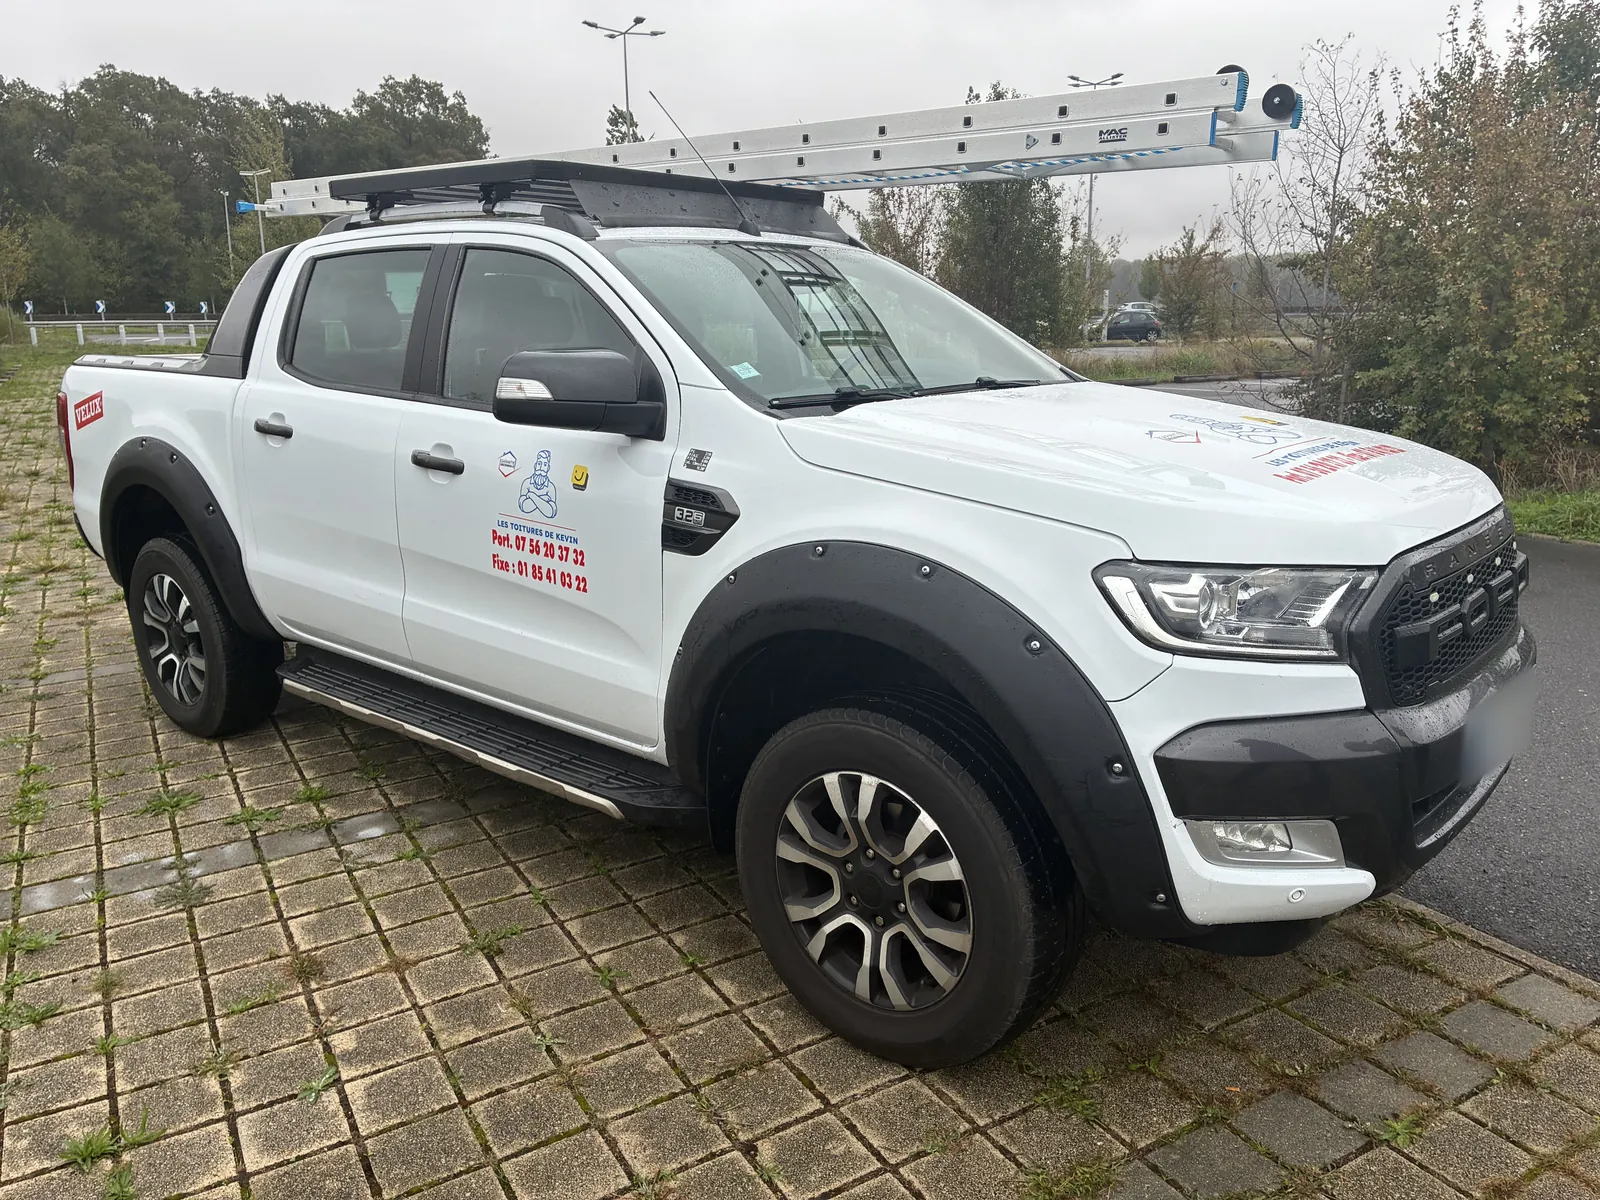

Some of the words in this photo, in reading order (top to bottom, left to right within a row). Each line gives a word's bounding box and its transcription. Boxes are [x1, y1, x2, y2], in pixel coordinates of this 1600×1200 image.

[1099, 127, 1127, 137] MAC
[75, 396, 102, 424] VELUX
[497, 519, 509, 529] LES
[510, 522, 543, 537] TOITURES
[544, 530, 554, 540] DE
[555, 532, 579, 545] KEVIN
[491, 528, 513, 549] Port.
[515, 534, 527, 552] 07
[529, 537, 541, 556] 56
[543, 541, 555, 560] 20
[557, 544, 570, 563] 37
[572, 548, 585, 567] 32
[491, 553, 510, 573] Fixe
[517, 560, 528, 578] 01
[531, 563, 543, 582] 85
[545, 567, 557, 585] 41
[560, 570, 573, 590] 03
[575, 574, 588, 594] 22
